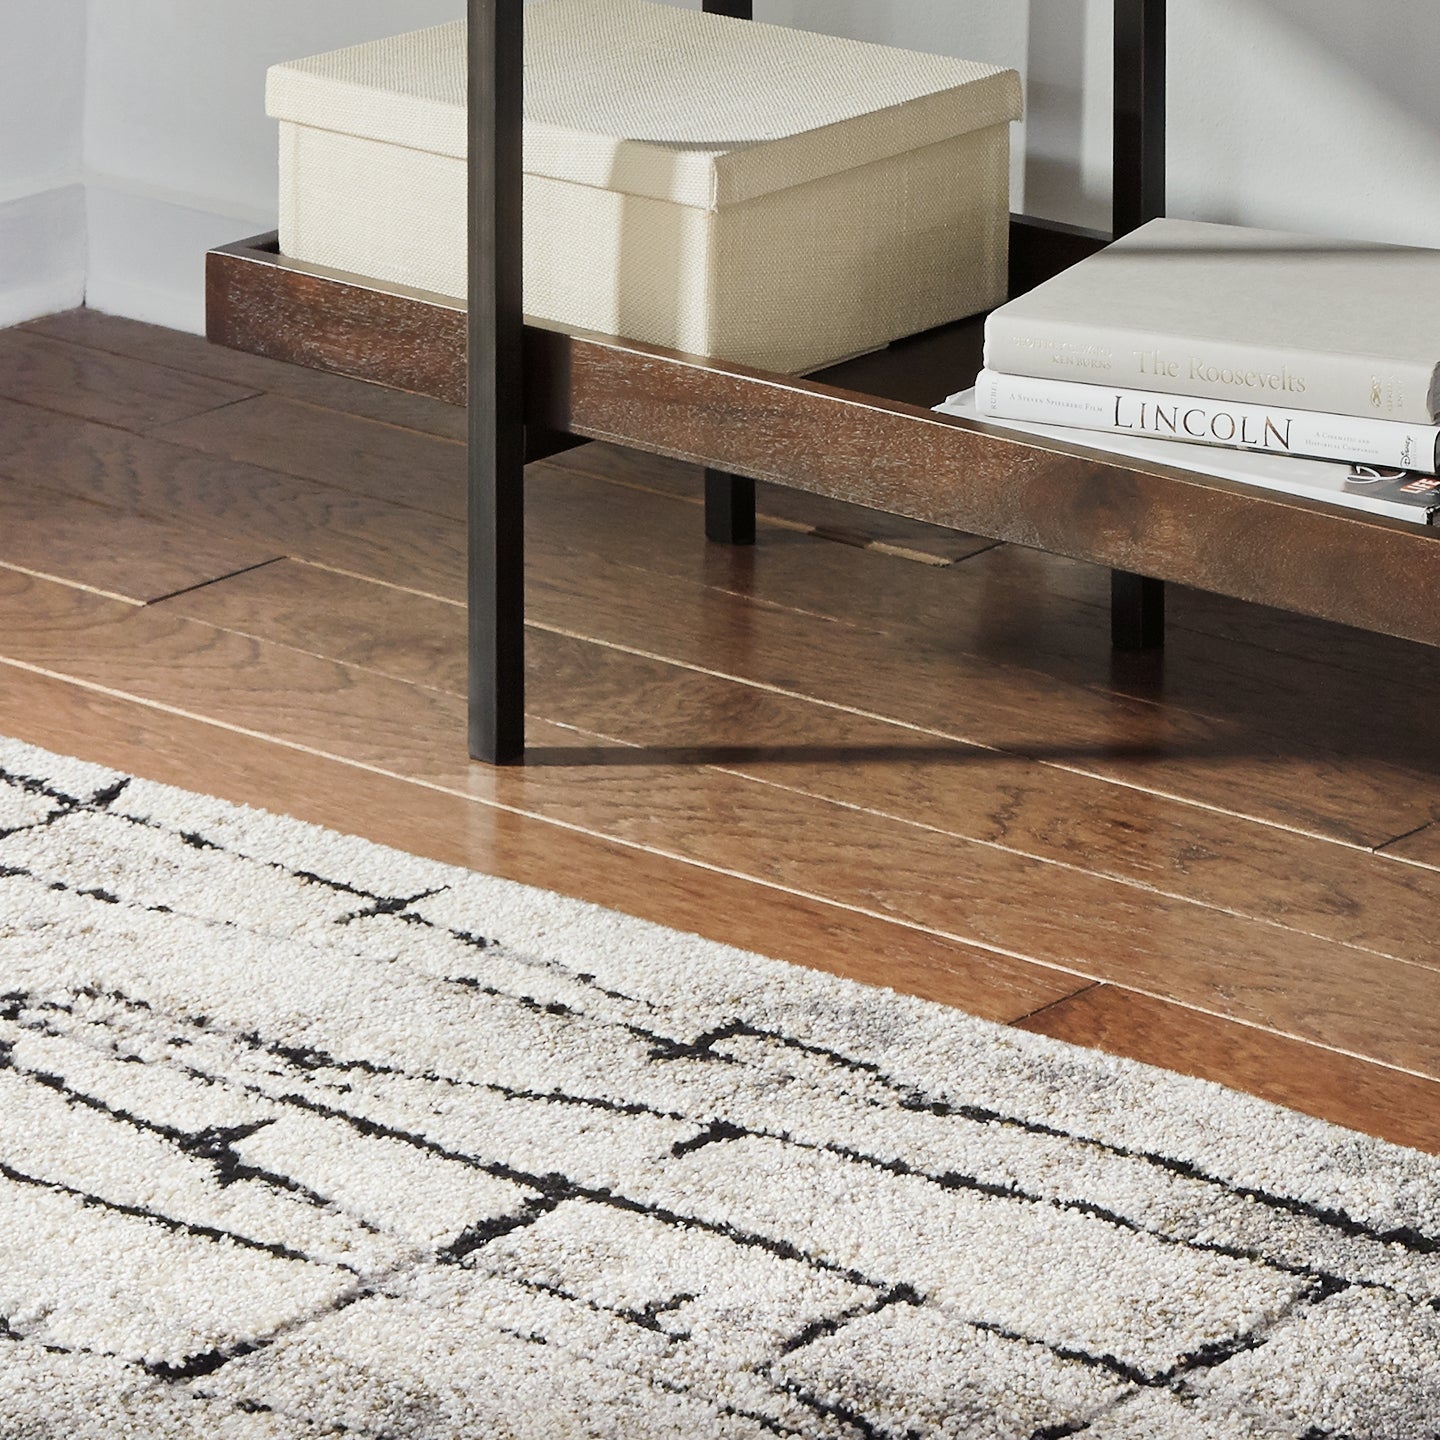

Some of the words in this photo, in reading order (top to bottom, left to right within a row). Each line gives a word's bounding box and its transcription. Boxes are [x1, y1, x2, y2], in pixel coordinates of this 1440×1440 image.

[1052, 355, 1075, 366] KEN
[1077, 358, 1112, 369] BURNS
[1134, 350, 1179, 377] The
[1188, 355, 1306, 393] Roosevelts
[991, 381, 999, 410] RUBEL
[1114, 395, 1293, 450] LINCOLN
[1400, 435, 1414, 468] Disney
[1401, 478, 1440, 494] LIFE
